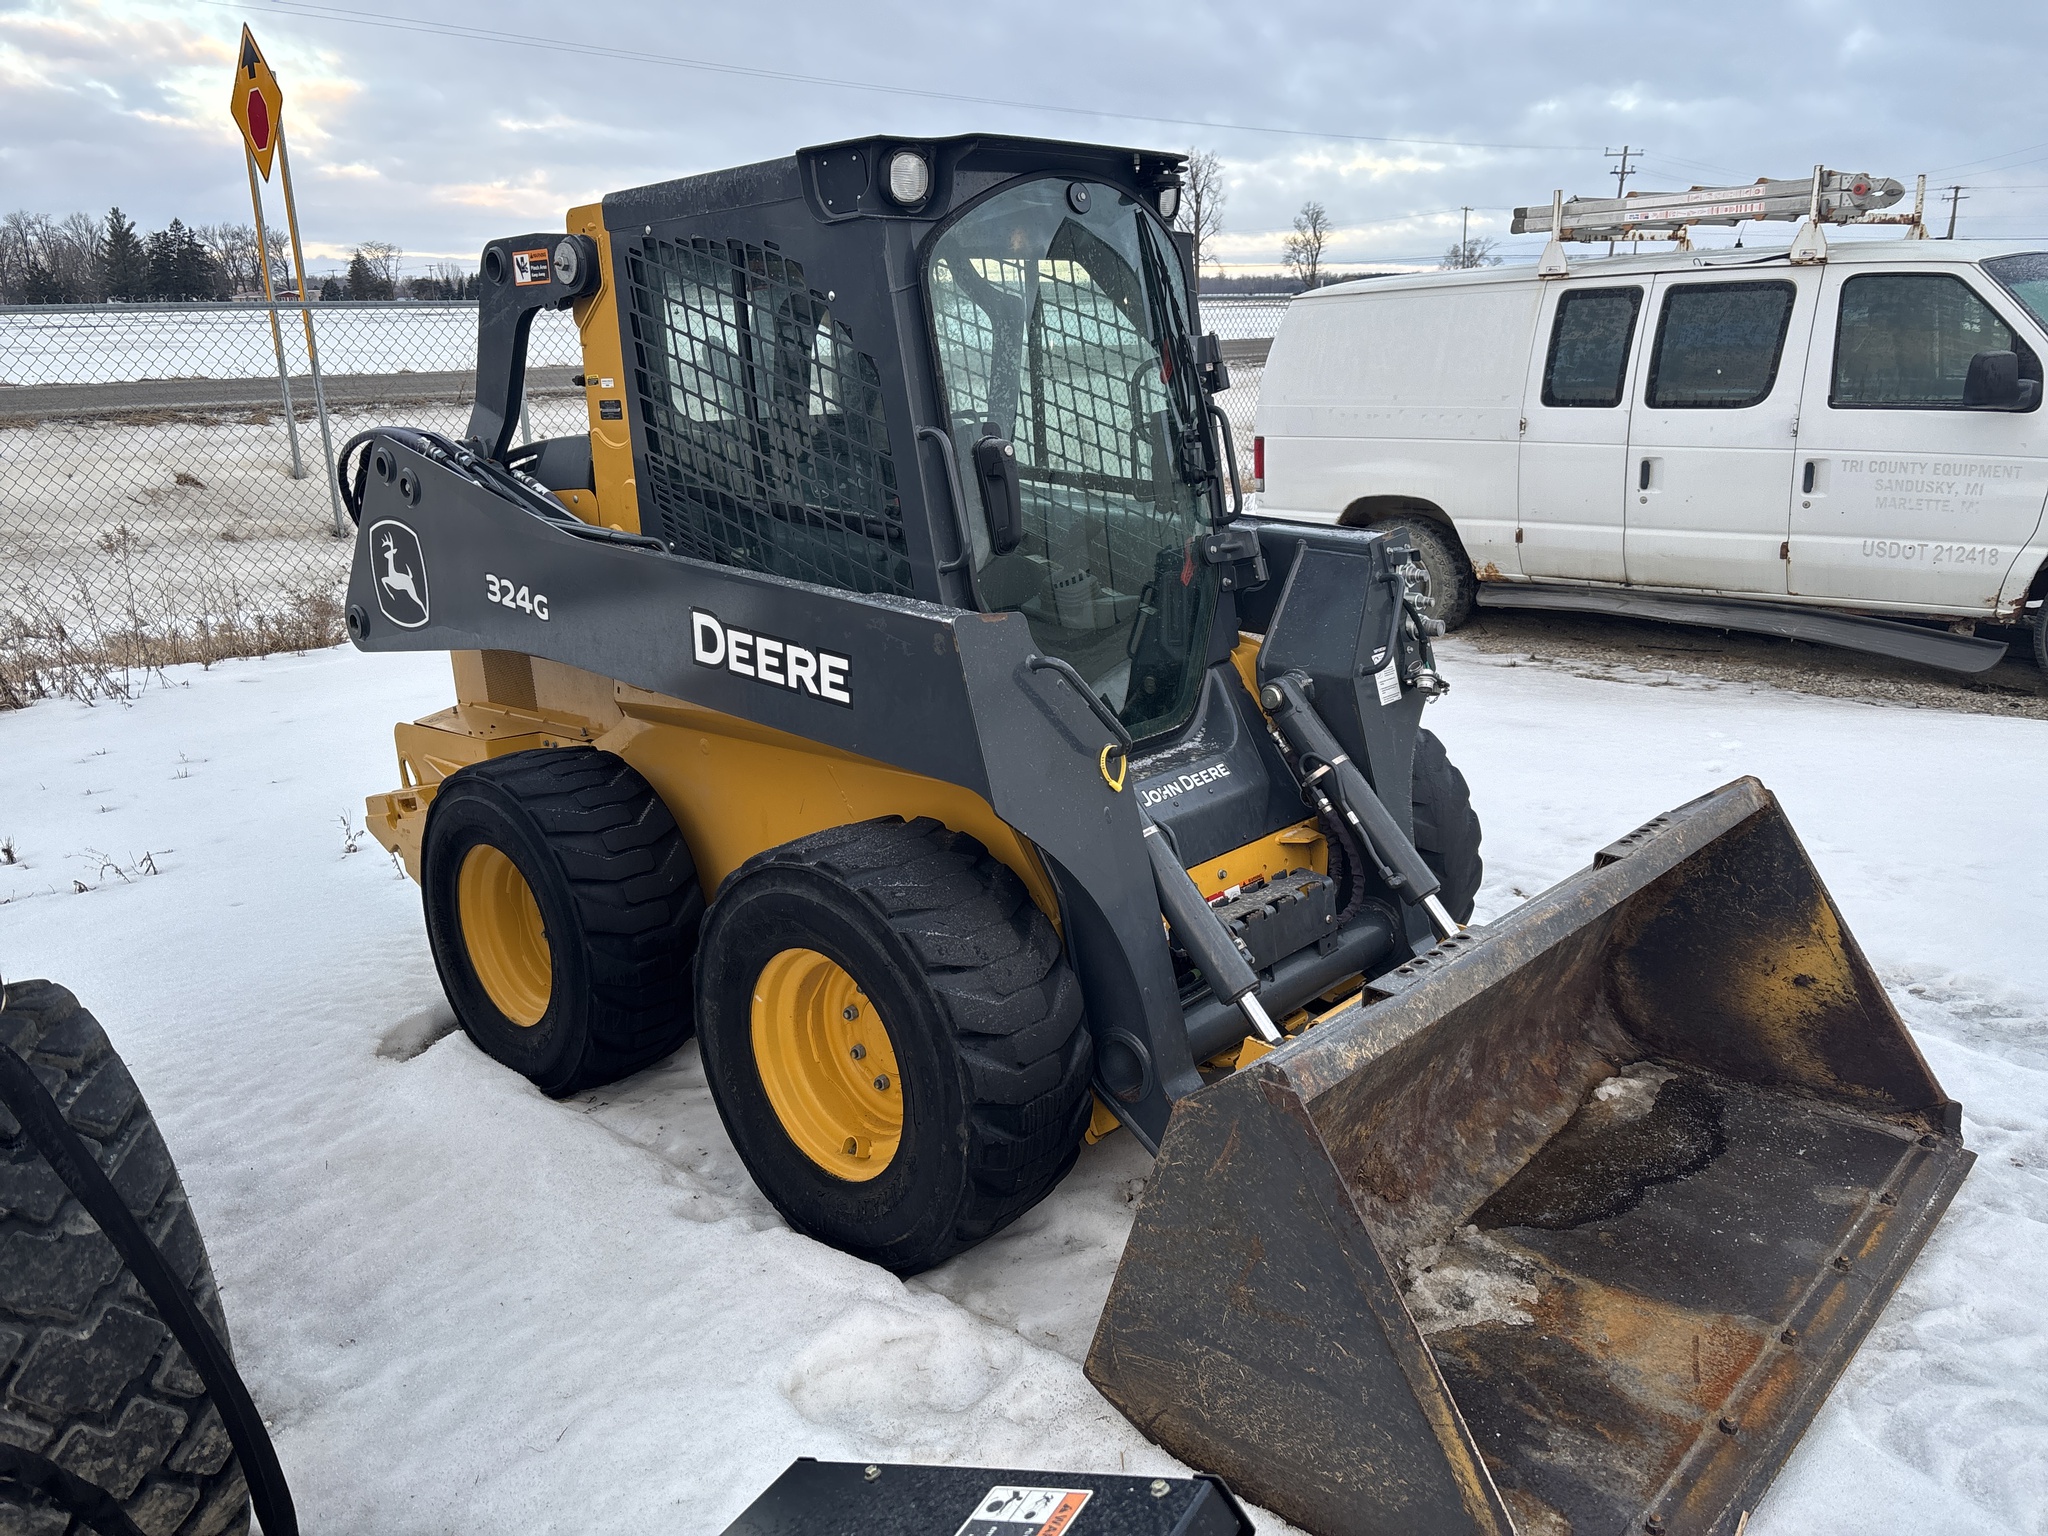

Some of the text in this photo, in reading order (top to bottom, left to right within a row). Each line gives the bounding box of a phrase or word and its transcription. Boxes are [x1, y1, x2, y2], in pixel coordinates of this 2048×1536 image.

[1841, 459, 2024, 479] TRI COUNTY EQUIPMENT
[1874, 479, 1985, 497] SANDUSKY, MI
[1862, 540, 2000, 566] USDOT 212418
[485, 573, 550, 621] 324G
[692, 611, 851, 704] DEERE
[1141, 763, 1230, 807] JOHN DEERE
